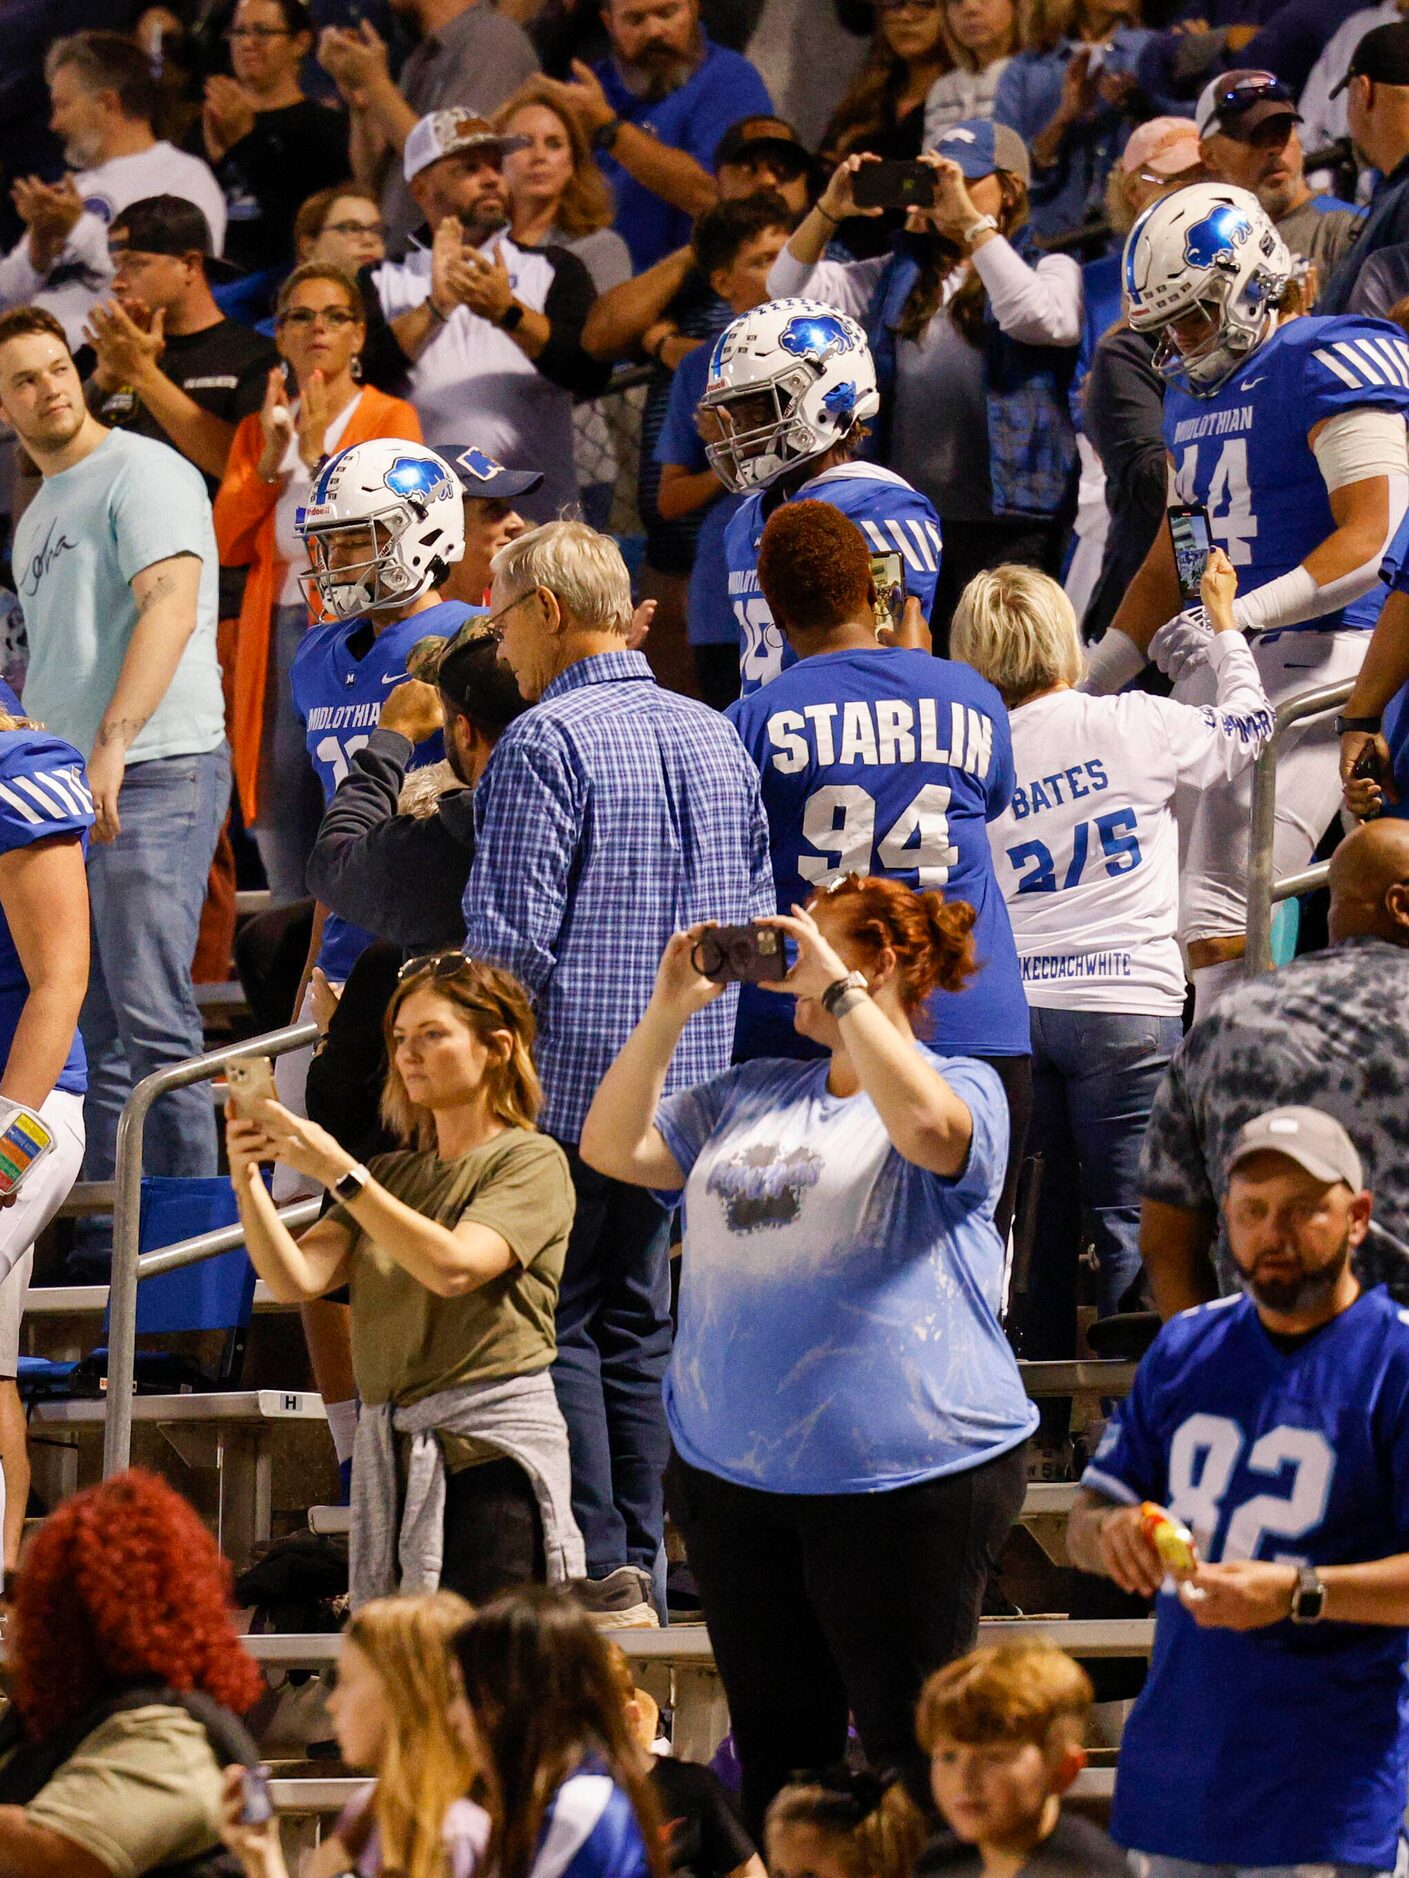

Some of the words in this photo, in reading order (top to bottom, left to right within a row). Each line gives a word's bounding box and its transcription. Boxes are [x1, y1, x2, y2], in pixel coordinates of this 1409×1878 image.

[306, 702, 382, 732] MIDLOTHIA
[316, 734, 370, 791] 1
[1011, 758, 1109, 821] BATES
[798, 783, 959, 886] 94
[1005, 806, 1143, 894] 2/5
[285, 1395, 297, 1410] H
[1168, 1411, 1336, 1568] 82
